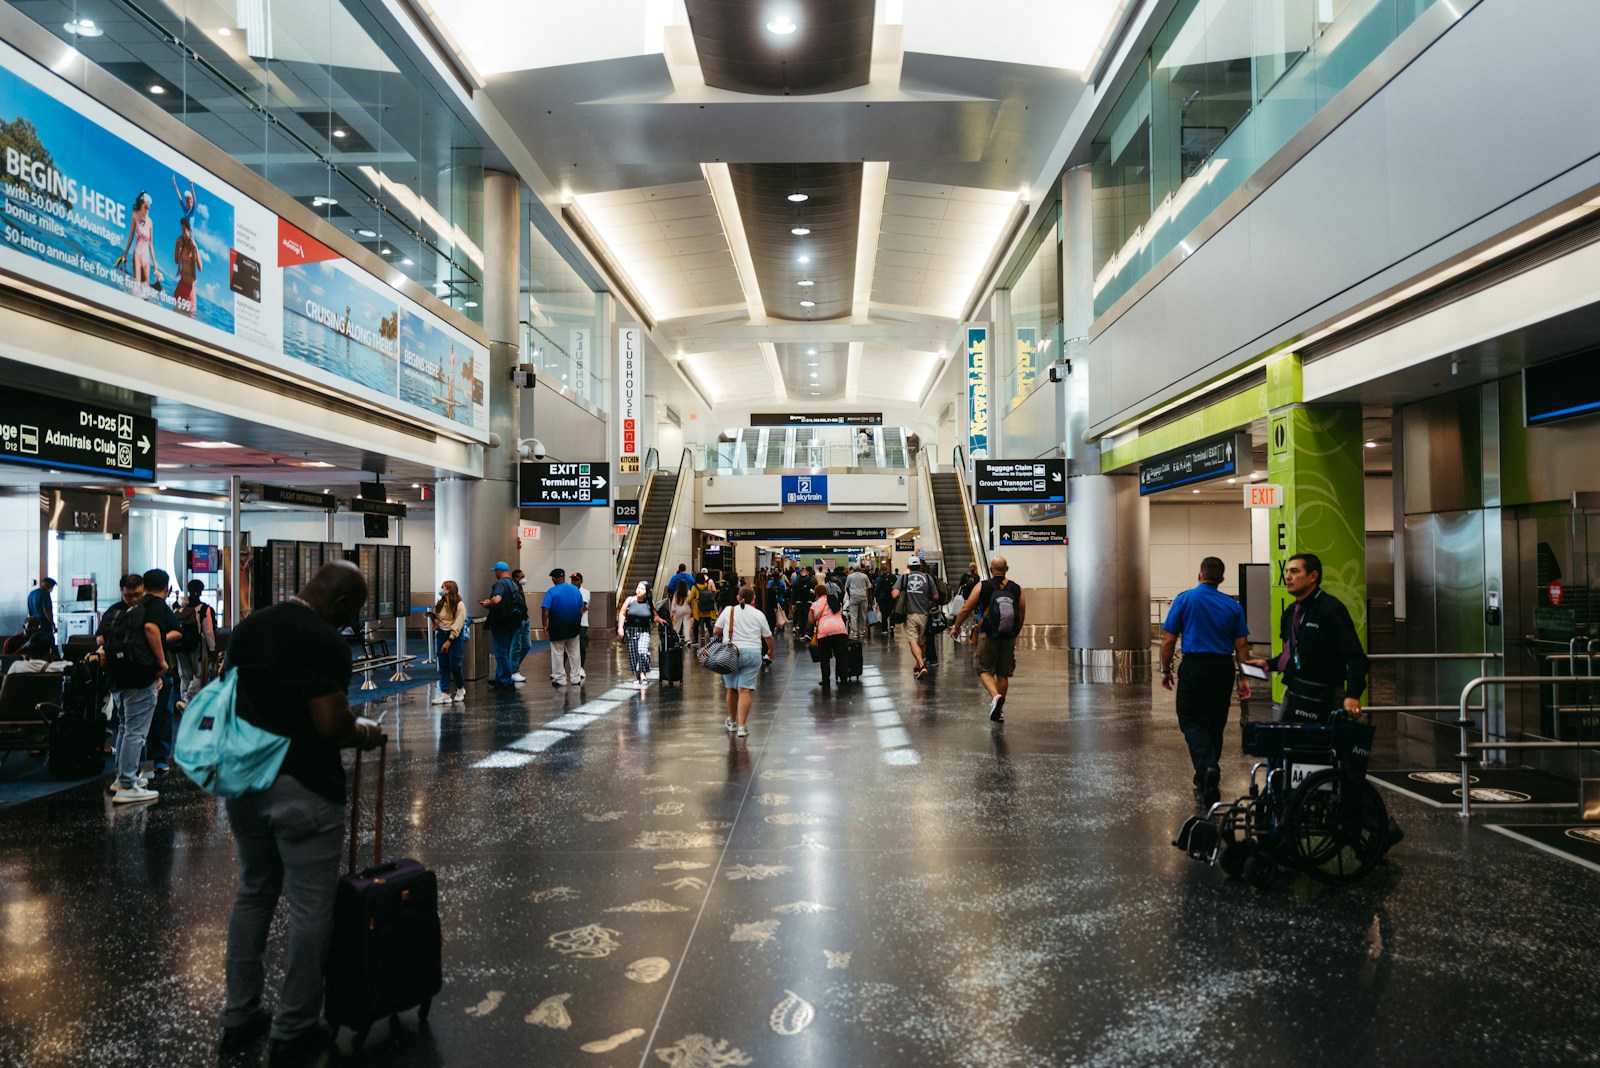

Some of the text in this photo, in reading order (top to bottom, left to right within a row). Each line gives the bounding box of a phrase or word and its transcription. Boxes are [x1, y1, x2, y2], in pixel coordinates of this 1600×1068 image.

[6, 146, 126, 229] BEGINS HERE
[5, 183, 29, 203] with
[31, 191, 66, 219] 50,000
[5, 198, 67, 238] bonus miles.
[5, 225, 19, 243] $0
[21, 232, 46, 254] intro
[46, 245, 79, 267] annual
[80, 256, 95, 274] fee
[96, 264, 109, 278] for
[110, 269, 124, 285] the
[125, 274, 141, 291] first
[141, 283, 160, 300] year,
[160, 290, 177, 307] then
[305, 299, 394, 353] CRUISING ALONG THERE
[404, 348, 425, 371] BEGINS
[424, 360, 439, 378] HERE
[625, 331, 634, 418] CLUBHOUSE
[80, 411, 117, 432] D1-D25
[45, 429, 117, 455] Admirals Club
[625, 420, 634, 452] one
[5, 441, 18, 451] D12
[550, 464, 578, 475] EXIT
[541, 478, 578, 486] Terminal
[801, 482, 809, 492] 2
[551, 491, 560, 499] G,
[562, 491, 571, 499] H,
[572, 491, 578, 499] J
[797, 493, 822, 502] skytrain
[1252, 488, 1275, 504] EXIT
[616, 506, 636, 515] D25
[524, 527, 537, 538] EXIT
[1295, 709, 1319, 719] envoy
